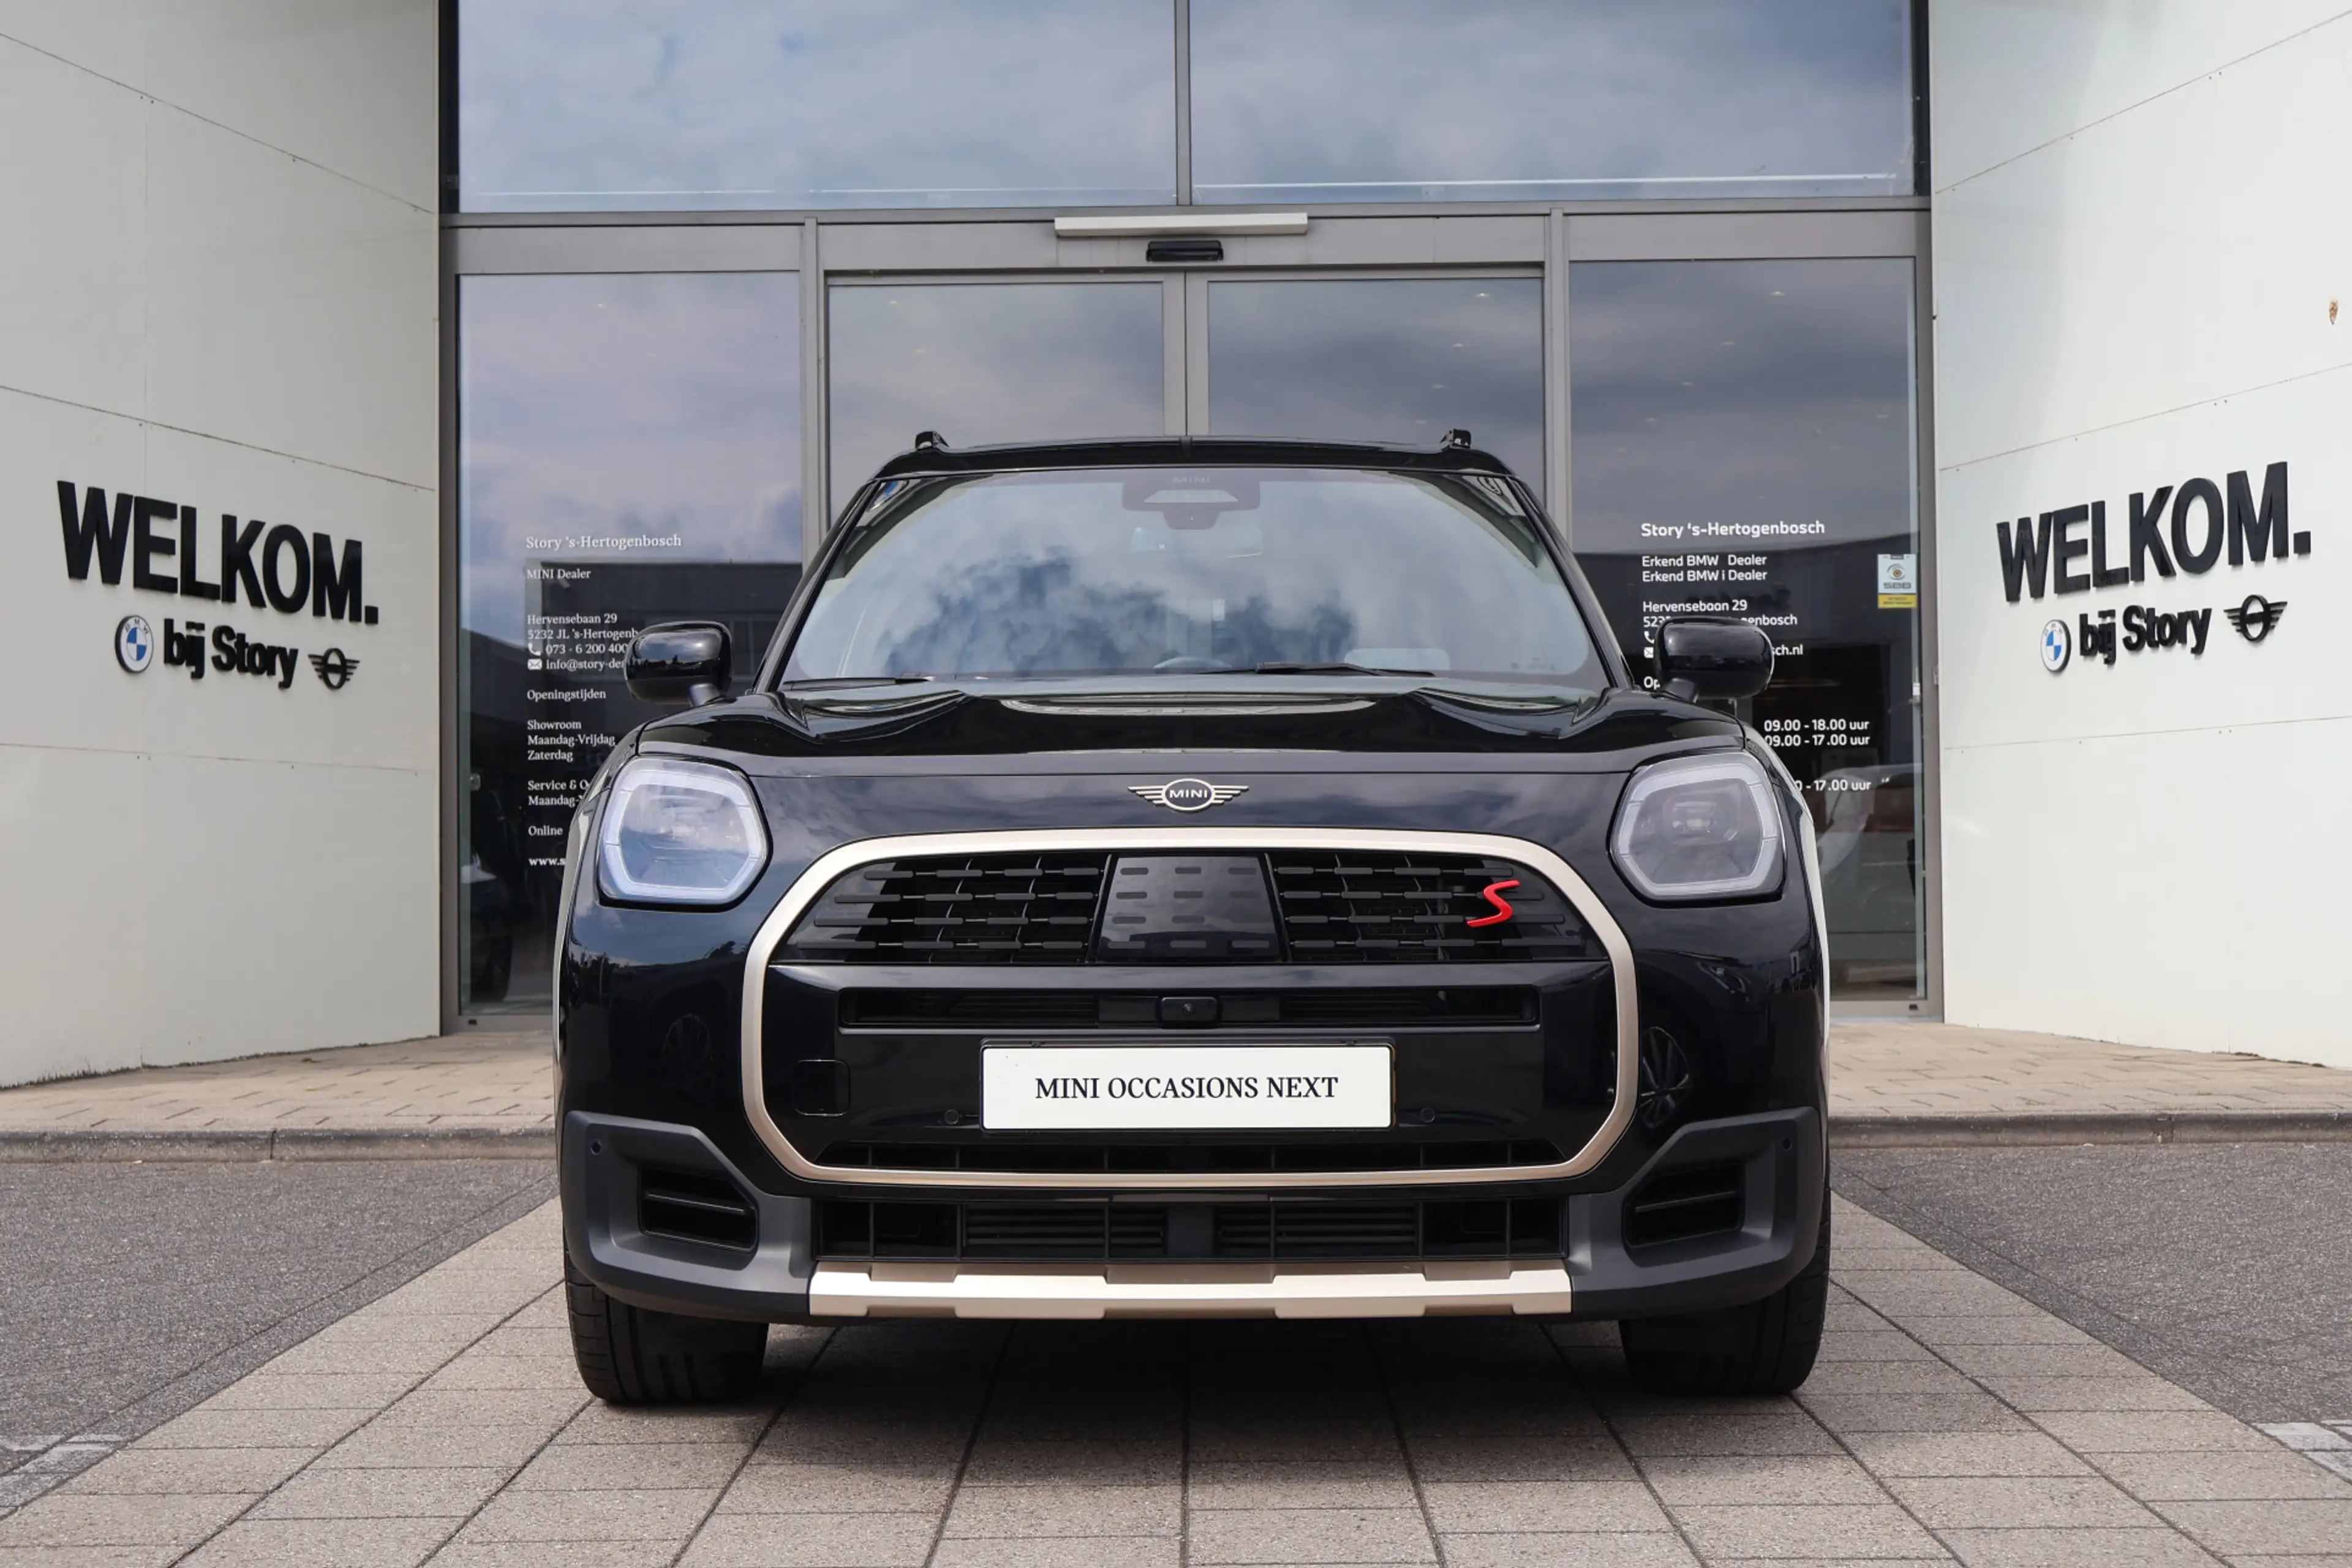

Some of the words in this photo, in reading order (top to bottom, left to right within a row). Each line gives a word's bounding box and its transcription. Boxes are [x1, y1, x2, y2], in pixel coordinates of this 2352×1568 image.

[1641, 523, 1684, 538] Story
[1996, 461, 2312, 603] WELKOM.
[526, 537, 562, 551] Story
[57, 480, 379, 625] WELKOM.
[1642, 555, 1683, 567] Erkend
[1686, 554, 1719, 567] BMW
[1728, 554, 1767, 565] Dealer
[526, 568, 554, 579] MINI
[557, 568, 591, 579] Dealer
[1642, 571, 1684, 582] Erkend
[1687, 570, 1719, 582] BMW
[1722, 569, 1725, 581] i
[1728, 568, 1768, 581] Dealer
[1643, 600, 1729, 612] Hervensebaan
[1732, 600, 1747, 611] 29
[527, 613, 601, 625] Hervensebaan
[604, 612, 617, 624] 29
[527, 630, 554, 640] 5232
[556, 629, 570, 639] JL
[2122, 605, 2212, 655] Story
[545, 644, 566, 655] 073
[575, 644, 582, 654] 6
[586, 643, 605, 654] 200
[211, 625, 299, 690] Story
[527, 688, 606, 703] Openingstijden
[527, 719, 582, 730] Showroom
[1763, 719, 1801, 732] 09.00
[1811, 718, 1847, 731] 18.00
[1849, 721, 1870, 731] uur
[527, 733, 616, 747] Maandag-Vrijdag
[1765, 734, 1801, 747] 09.00
[1850, 736, 1871, 745] uur
[527, 749, 573, 763] Zaterdag
[527, 780, 567, 791] Service
[569, 779, 576, 790] &
[1851, 781, 1872, 791] uur
[1169, 789, 1208, 799] MINI
[528, 825, 563, 836] Online
[1466, 880, 1521, 928] S
[1035, 1077, 1099, 1099] MINI
[1107, 1077, 1259, 1099] OCCASIONS
[1266, 1076, 1339, 1098] NEXT
